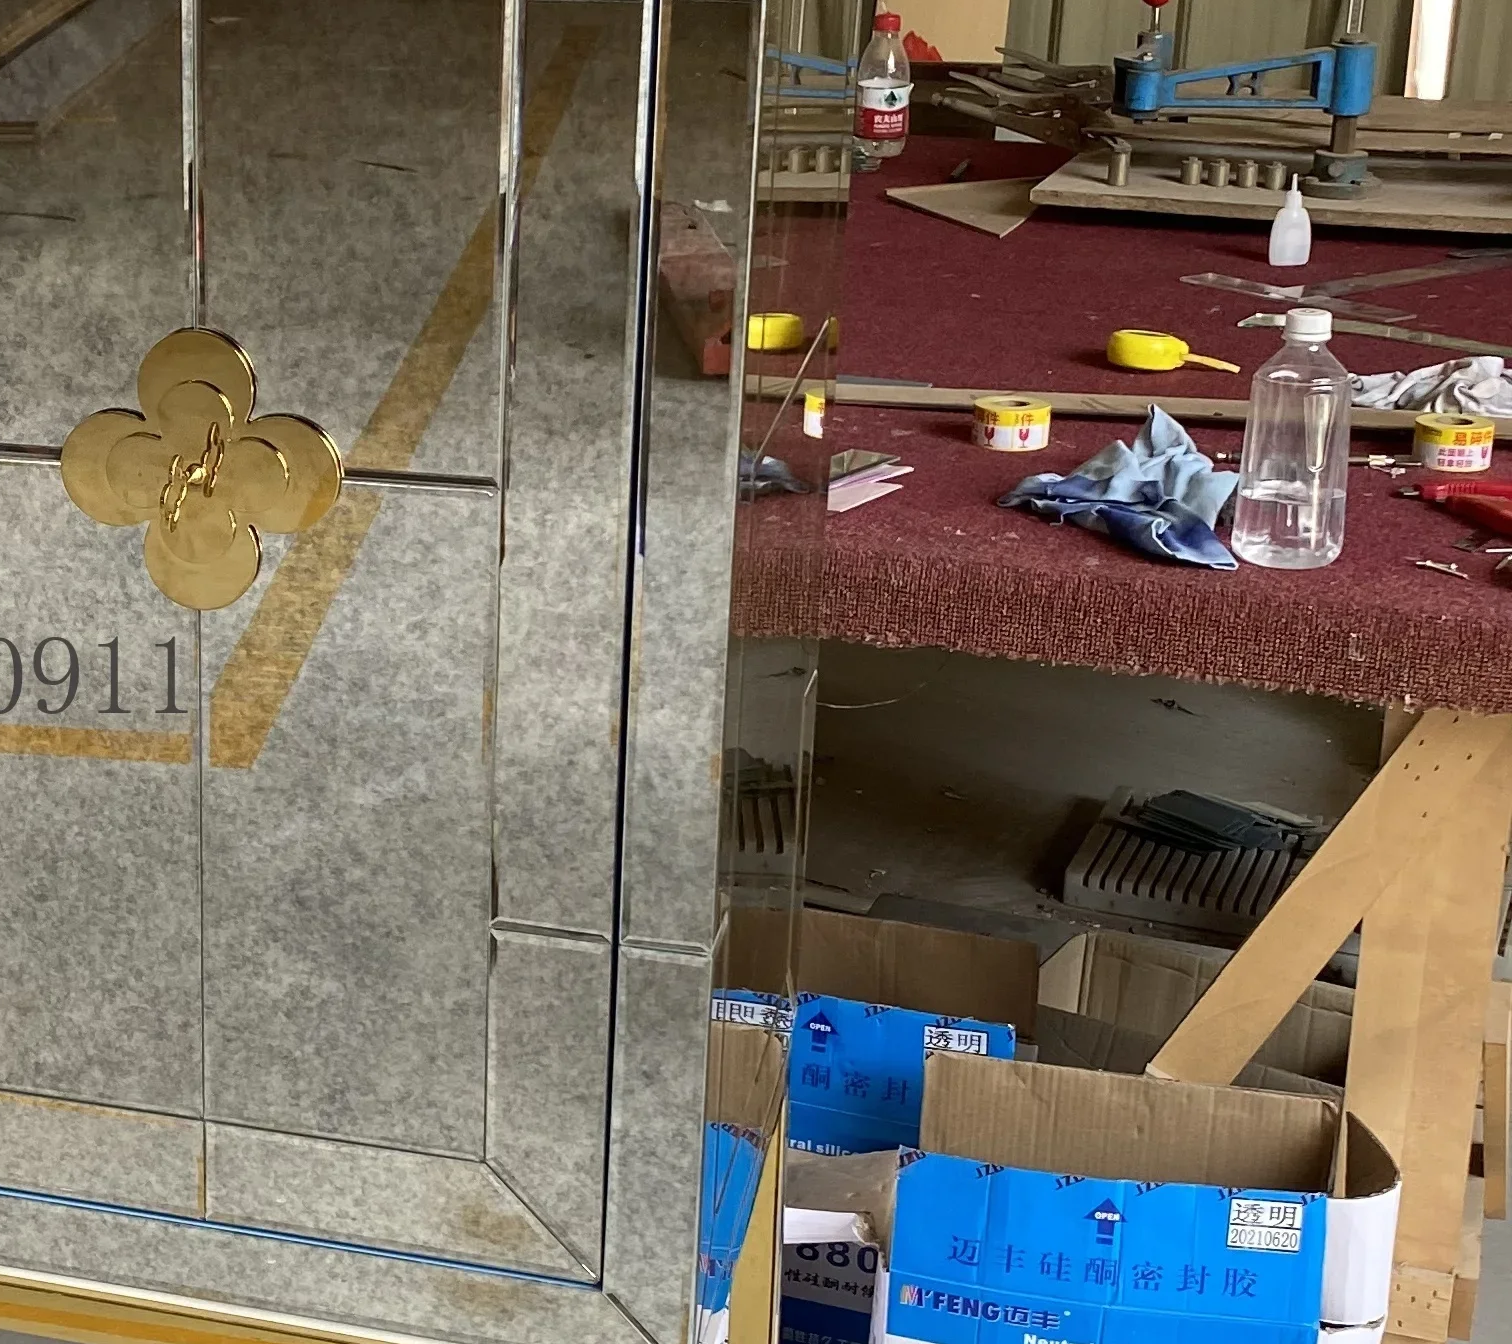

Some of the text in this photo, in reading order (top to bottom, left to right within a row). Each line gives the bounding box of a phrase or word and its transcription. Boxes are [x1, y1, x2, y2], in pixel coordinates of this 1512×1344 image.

[809, 1022, 832, 1033] OPEN
[925, 1029, 982, 1054] 透明
[1094, 1211, 1120, 1221] OPEN
[1232, 1202, 1298, 1228] 透明
[1230, 1228, 1298, 1248] 20210620
[947, 1235, 1258, 1298] 迈丰硅酮密封胶
